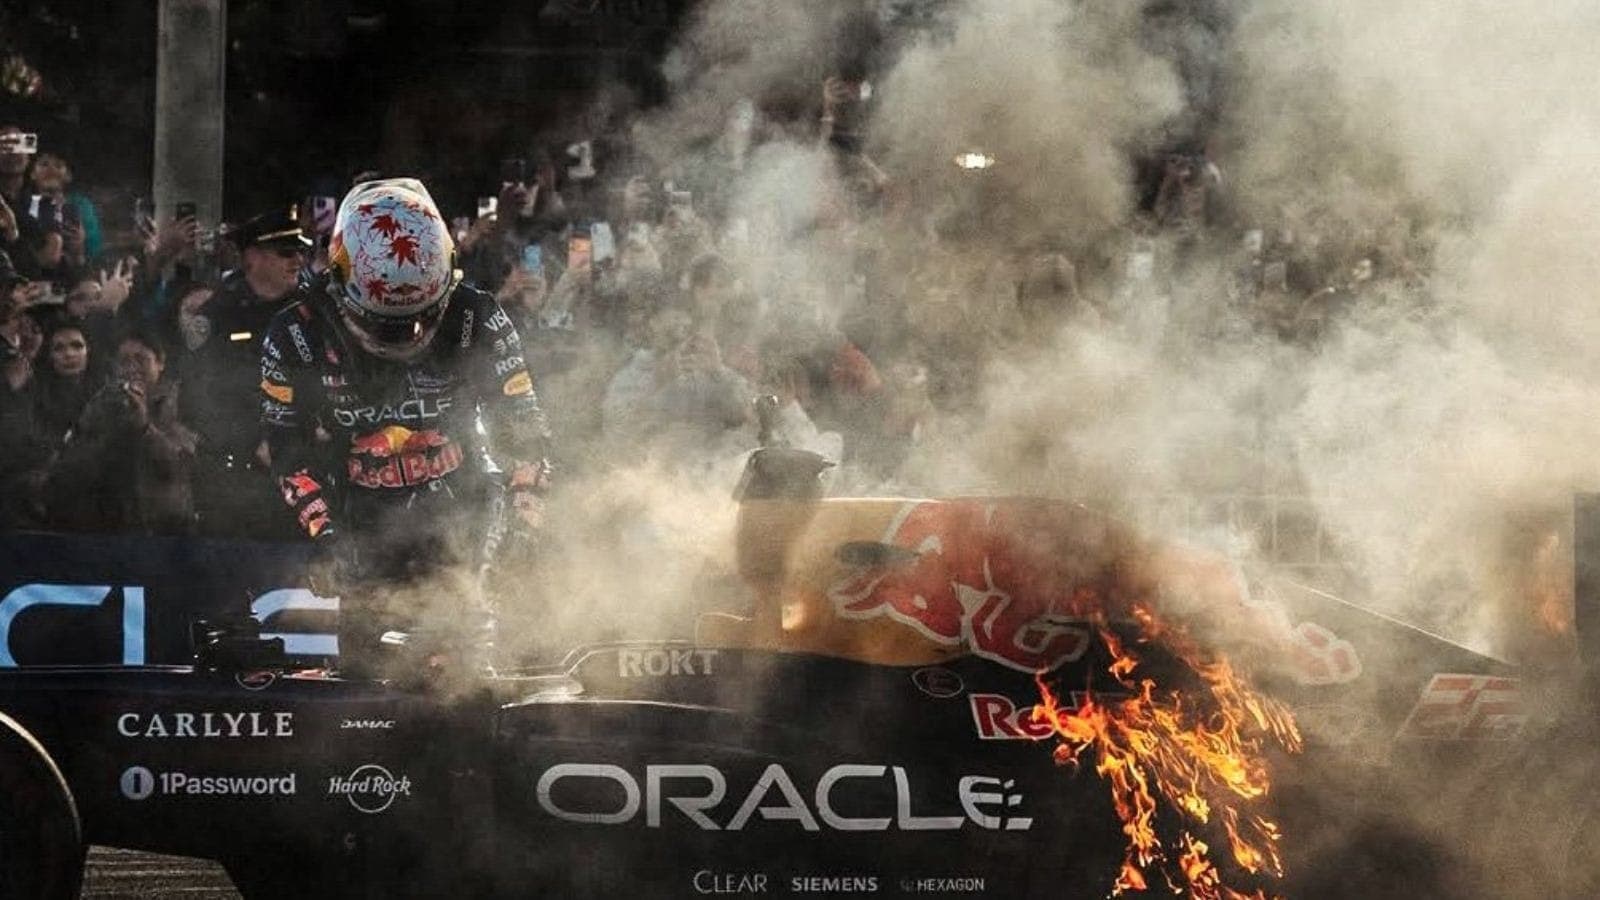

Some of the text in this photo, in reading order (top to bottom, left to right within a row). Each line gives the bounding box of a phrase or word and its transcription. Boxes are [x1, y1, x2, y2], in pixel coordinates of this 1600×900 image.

[618, 648, 719, 678] ROKT
[117, 712, 295, 738] CARLYLE
[159, 772, 297, 795] 1Password
[328, 775, 412, 797] Hard Rock
[536, 762, 1034, 832] ORACLE
[692, 869, 768, 894] CLEAR
[791, 876, 879, 892] SIEMENS
[916, 878, 985, 892] HEXAGON
